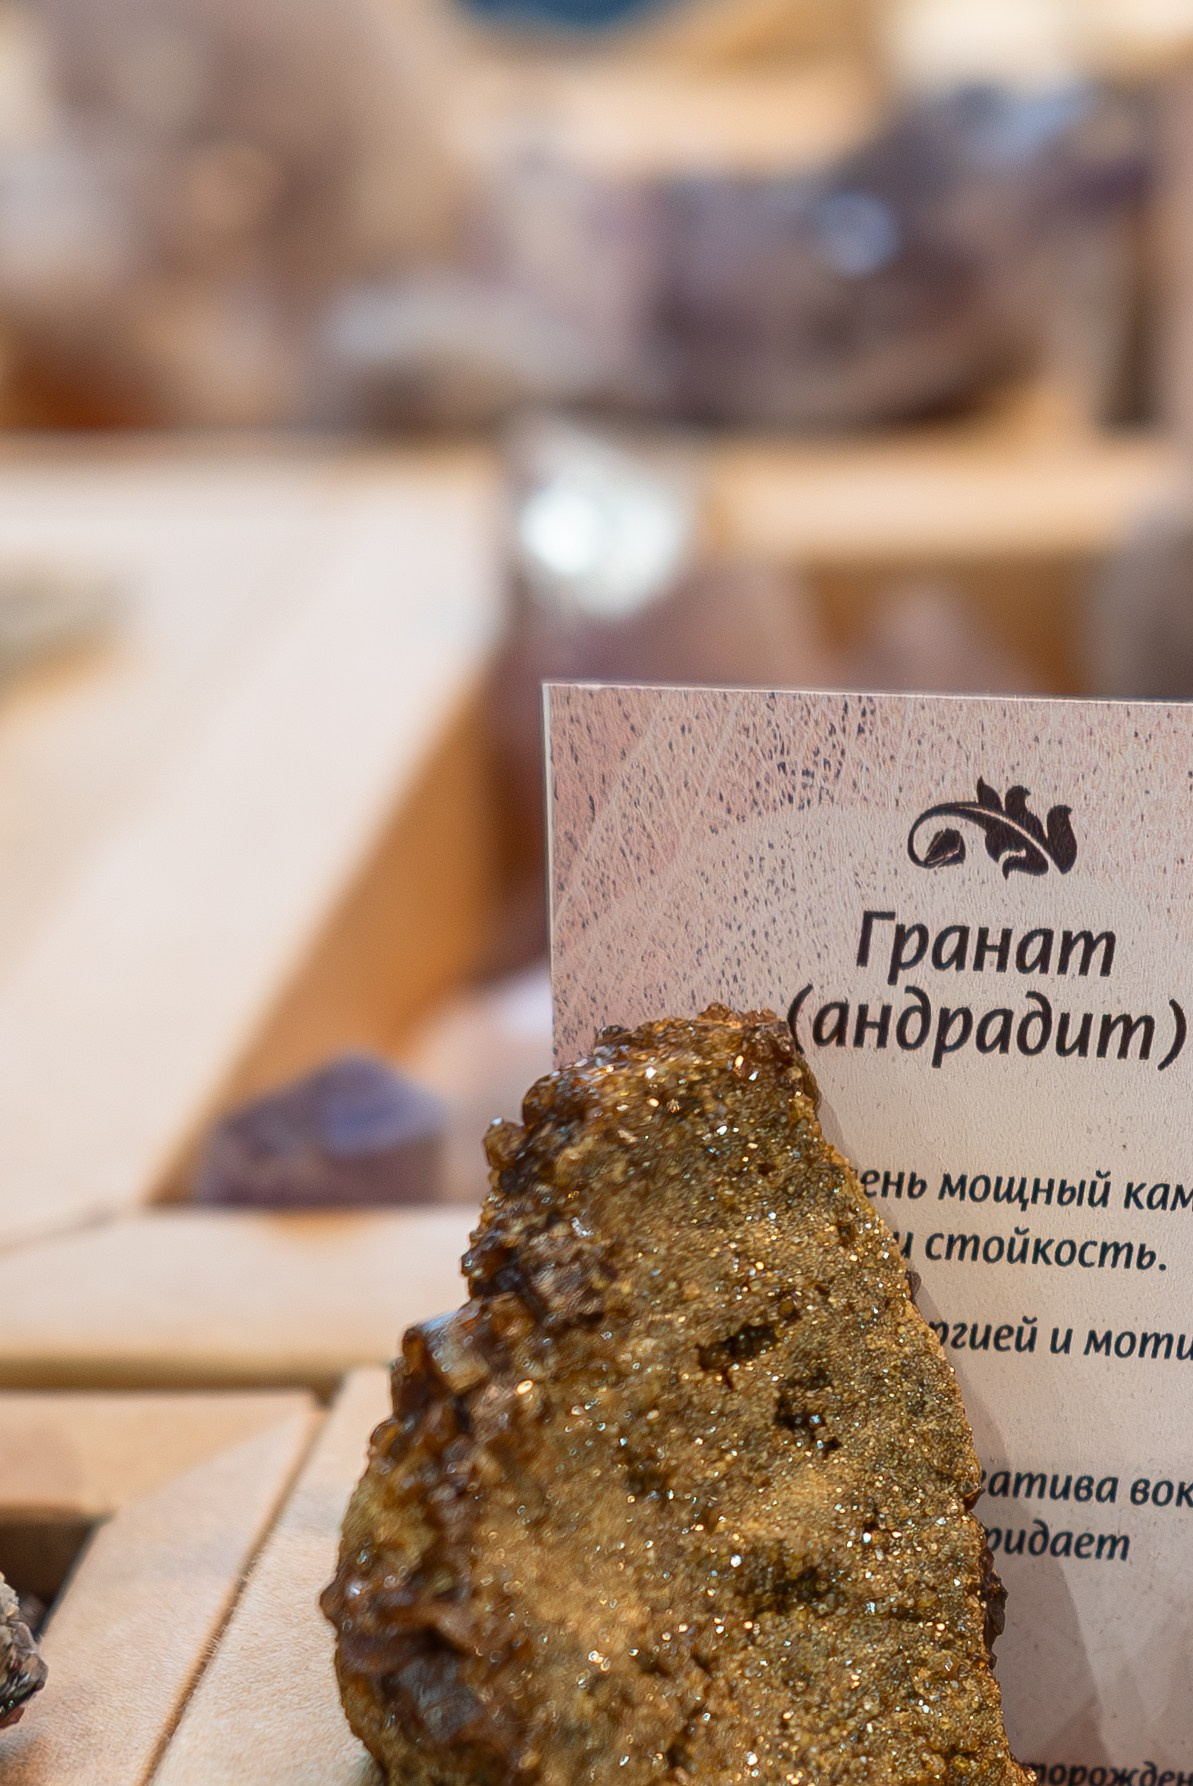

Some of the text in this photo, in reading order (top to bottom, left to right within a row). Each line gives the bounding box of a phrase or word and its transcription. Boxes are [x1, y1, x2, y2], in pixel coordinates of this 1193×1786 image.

[855, 909, 1117, 986] Гранат
[786, 983, 1188, 1071] (андрадит)
[854, 1168, 928, 1200] ень
[938, 1170, 1111, 1212] мощный
[924, 1226, 1168, 1272] стойкость.
[1049, 1325, 1074, 1356] и
